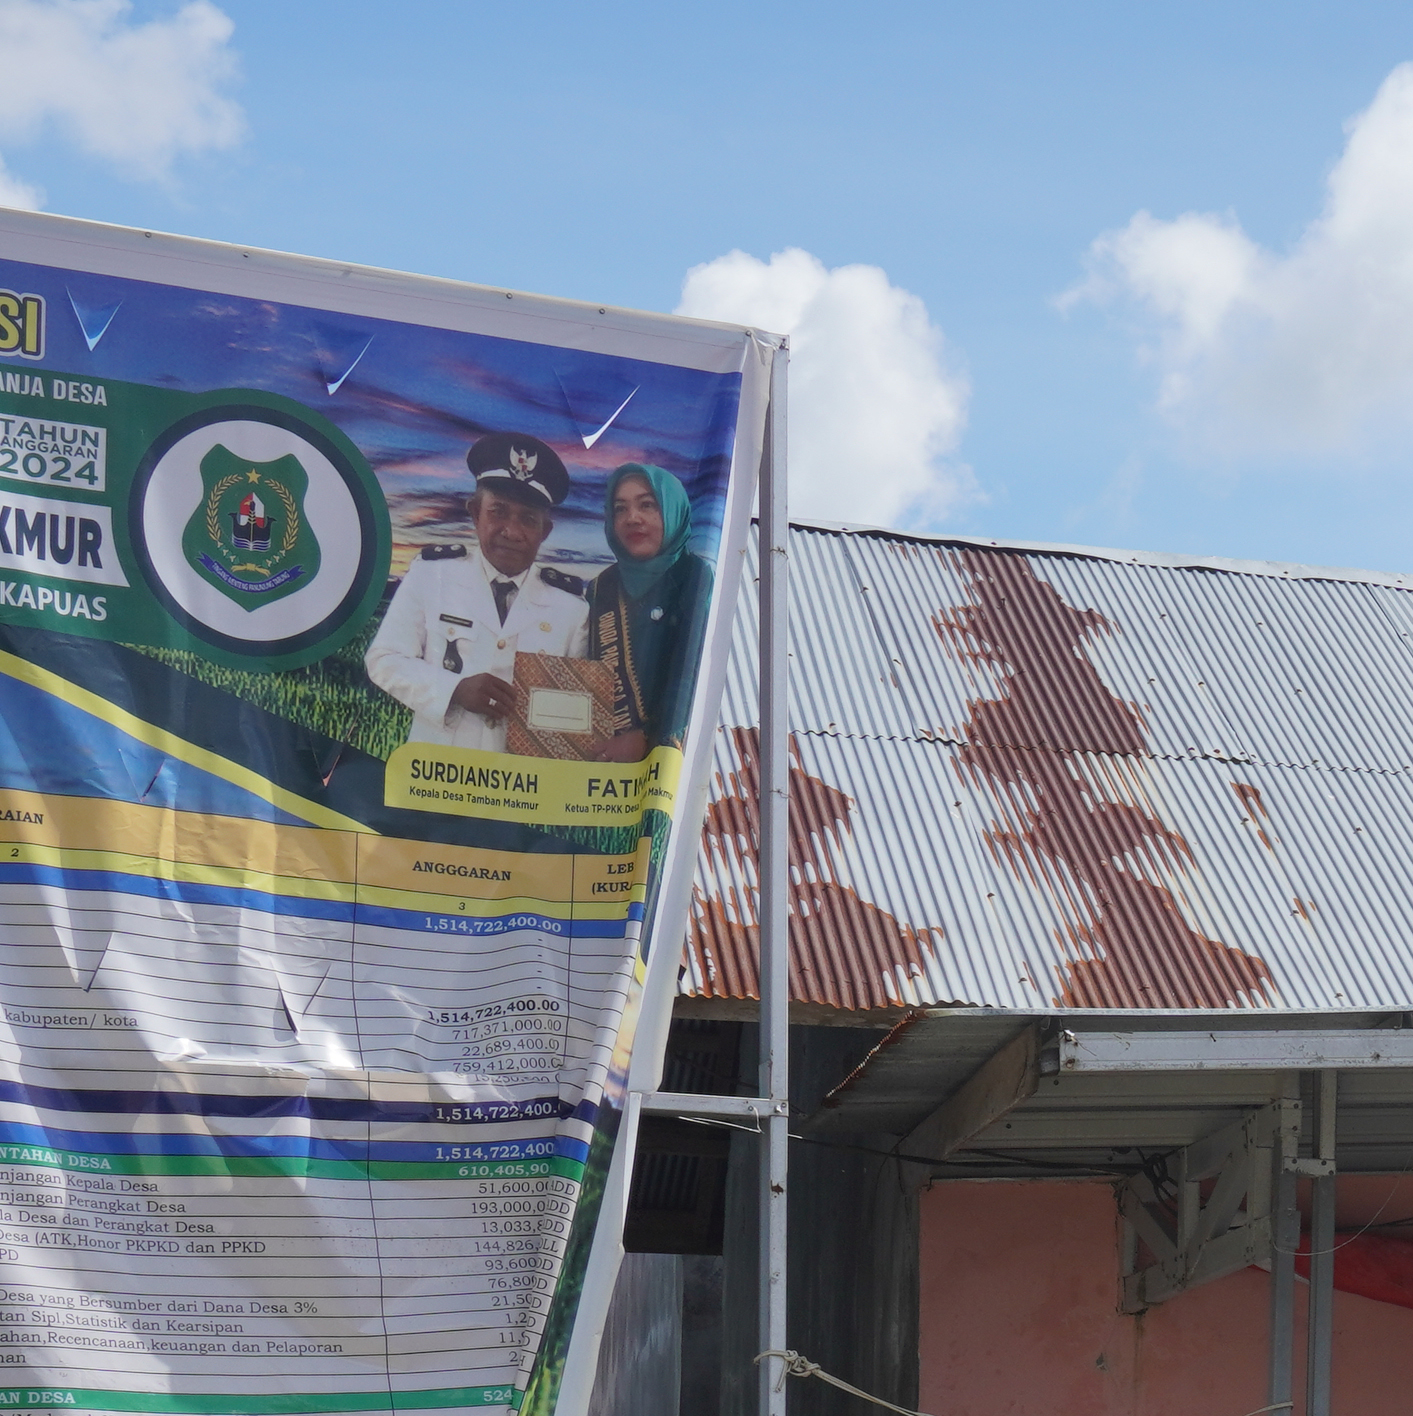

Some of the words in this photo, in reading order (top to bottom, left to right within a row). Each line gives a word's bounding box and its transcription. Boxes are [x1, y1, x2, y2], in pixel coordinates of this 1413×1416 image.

[53, 379, 107, 407] DESA
[1, 418, 99, 448] TAHUN
[0, 436, 98, 460] ANGGARAN
[0, 450, 98, 486] 2024
[0, 581, 107, 621] KAPUAS
[411, 759, 538, 793] SURDIANSYAH
[410, 786, 440, 800] Kepala
[442, 790, 464, 801] Desa
[467, 793, 500, 806] Tamban
[503, 797, 539, 810] Makmur
[565, 803, 589, 813] Ketua
[592, 804, 622, 814] TP-PKK
[11, 848, 19, 857] 2
[412, 860, 511, 880] ANGGGARAN
[459, 902, 465, 911] 3
[426, 916, 561, 934] 1,514,722,400.00
[4, 1010, 96, 1029] kabupaten/
[103, 1015, 138, 1026] kota
[68, 1157, 112, 1170] DESA
[66, 1175, 114, 1192] Kepala
[120, 1180, 159, 1192] Desa
[68, 1195, 141, 1212] Perangkat
[146, 1201, 186, 1213] Desa
[126, 1239, 179, 1253] PKPKD
[185, 1242, 215, 1253] dan
[221, 1242, 266, 1253] PPKD
[79, 1296, 162, 1313] Bersumber
[167, 1300, 197, 1313] dari
[204, 1302, 244, 1313] Dana
[250, 1303, 288, 1314] Desa
[294, 1303, 318, 1314] 3%
